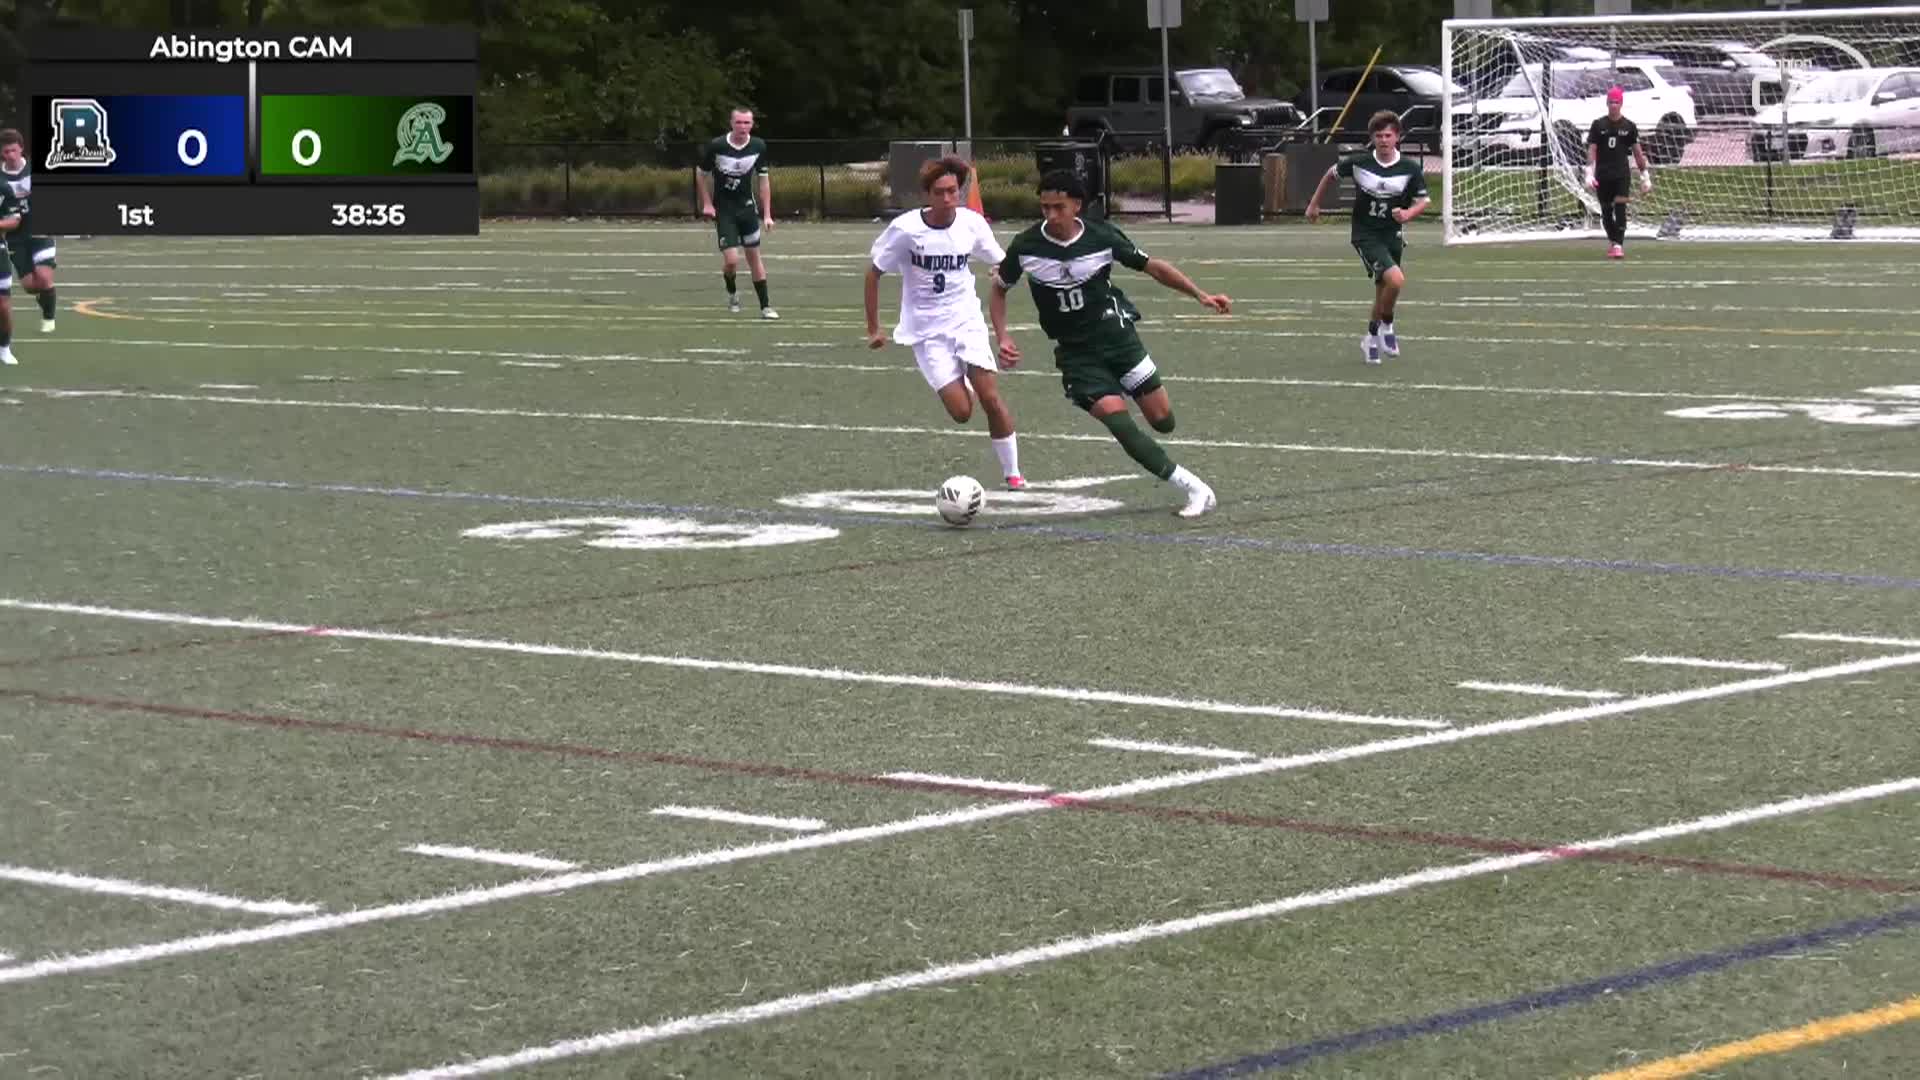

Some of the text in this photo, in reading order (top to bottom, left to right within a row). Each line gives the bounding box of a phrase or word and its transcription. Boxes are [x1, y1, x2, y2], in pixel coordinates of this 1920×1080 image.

[1369, 200, 1388, 218] 12
[933, 273, 946, 294] 9
[1056, 288, 1085, 313] 10
